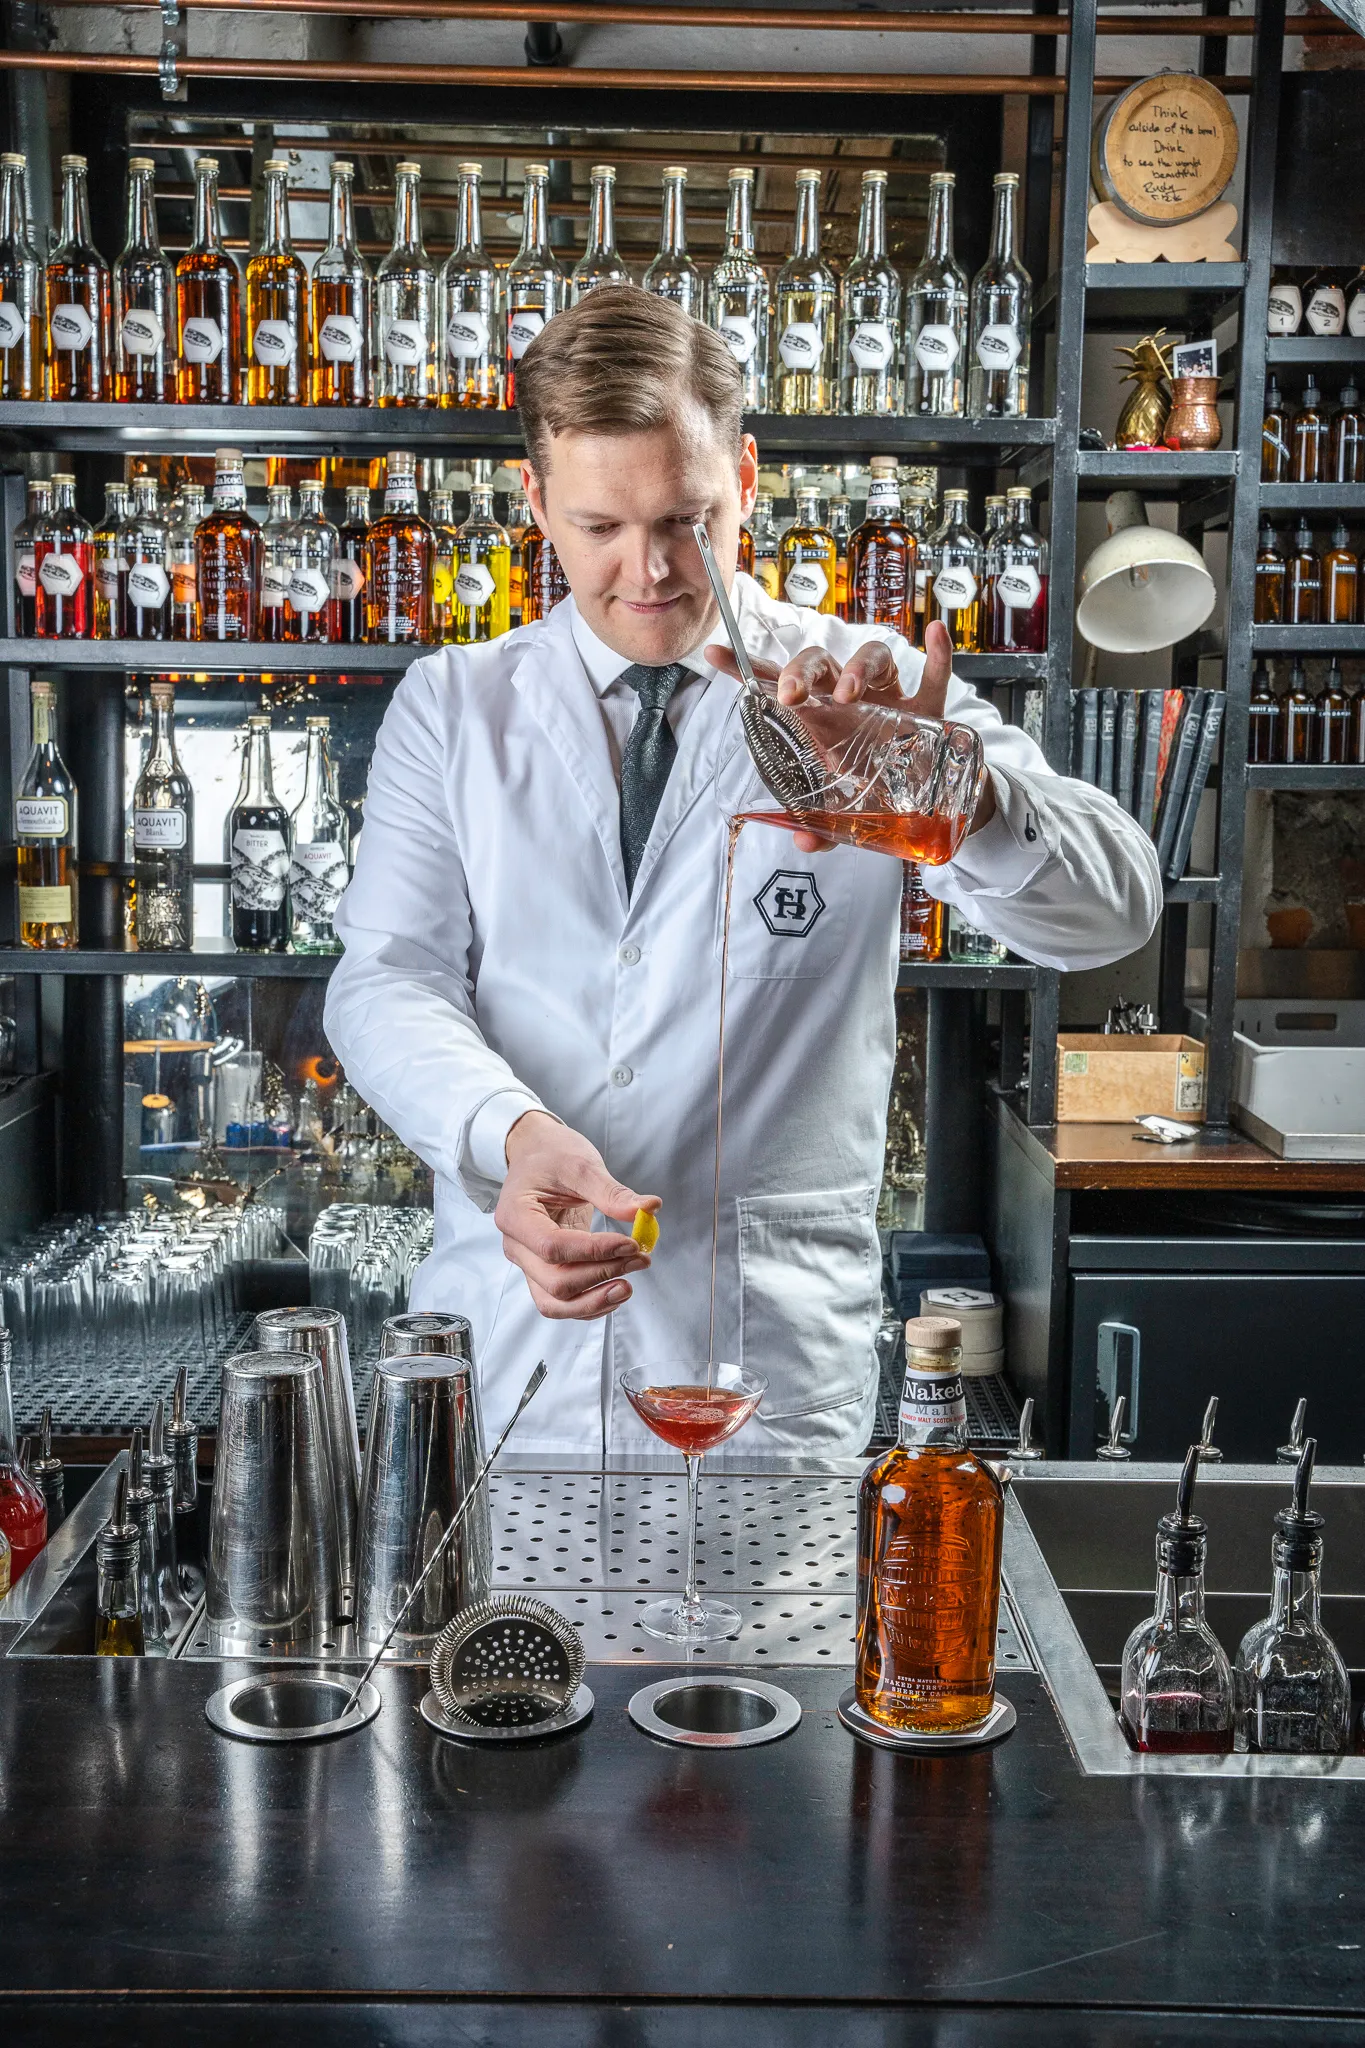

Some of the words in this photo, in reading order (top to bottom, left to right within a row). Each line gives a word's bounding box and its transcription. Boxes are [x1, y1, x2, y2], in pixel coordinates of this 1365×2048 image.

[1152, 104, 1188, 119] Think
[1164, 122, 1177, 134] of
[1180, 124, 1194, 135] the
[1153, 140, 1185, 154] Drink
[1123, 154, 1133, 167] to
[1158, 157, 1172, 168] the
[858, 289, 891, 297] TEQUIA
[1279, 317, 1284, 326] 1
[1323, 318, 1331, 327] 2
[19, 805, 59, 815] AQUAVIT
[137, 817, 177, 827] AQUAVIT
[304, 852, 332, 860] AQUAVIT
[904, 1377, 964, 1401] Naked
[915, 1405, 955, 1416] Malt
[933, 1416, 952, 1424] SCOTCH
[884, 1677, 912, 1689] NAKED
[892, 1686, 926, 1697] SHERRY
